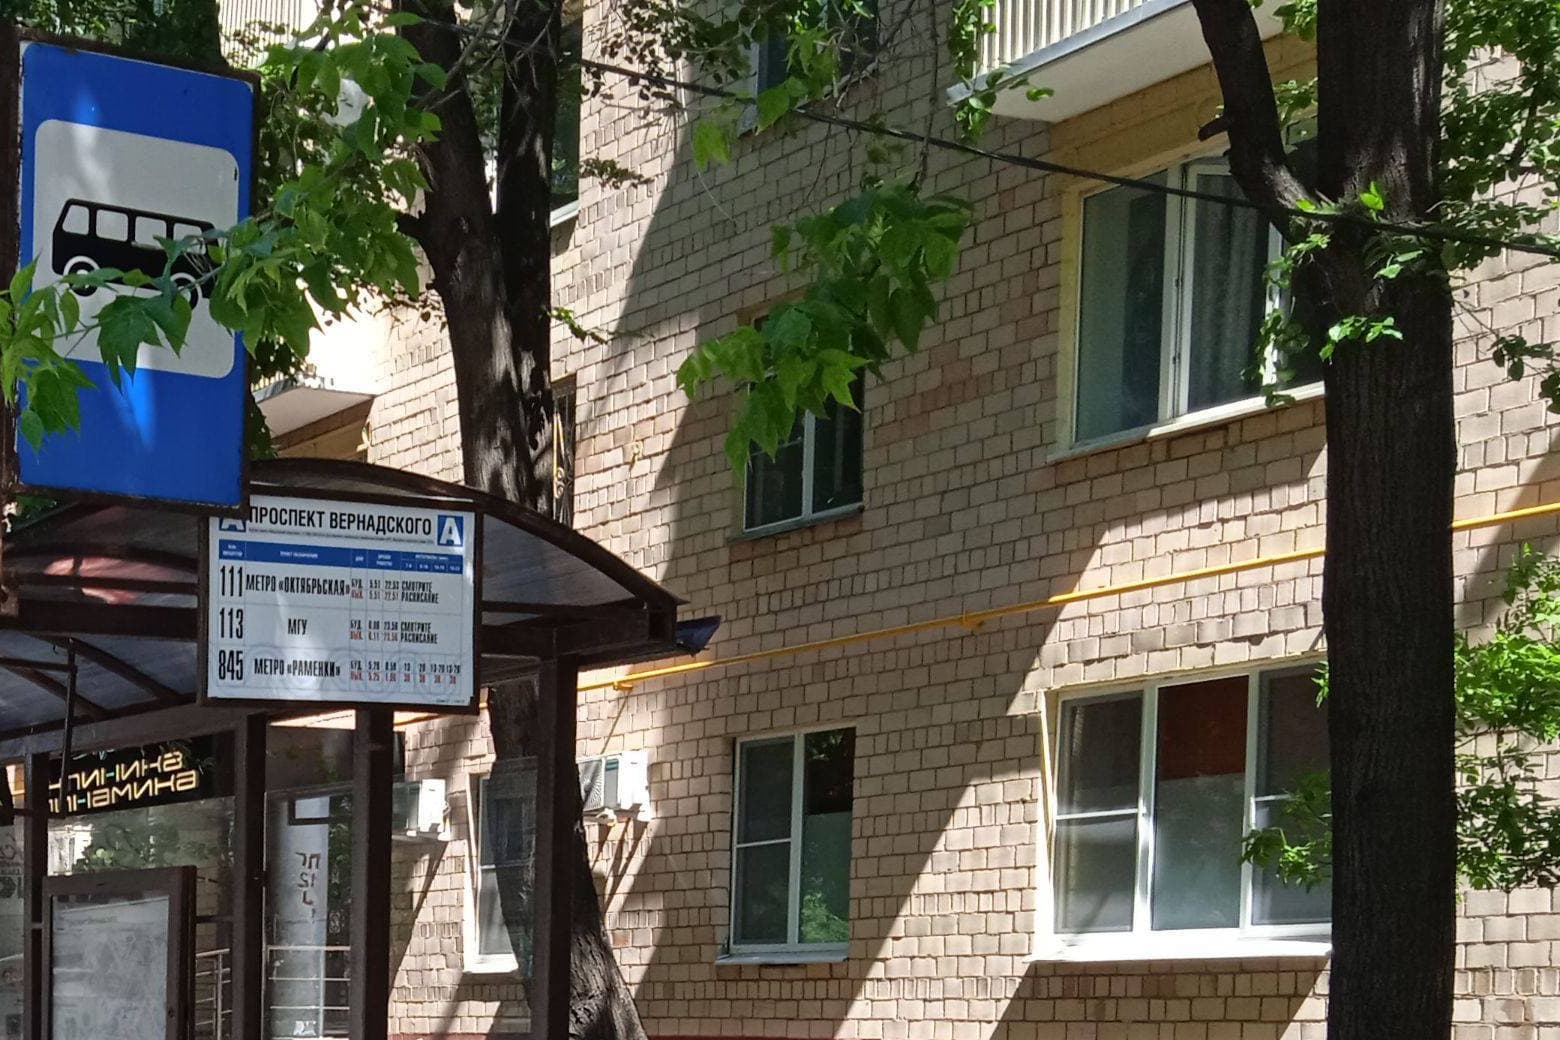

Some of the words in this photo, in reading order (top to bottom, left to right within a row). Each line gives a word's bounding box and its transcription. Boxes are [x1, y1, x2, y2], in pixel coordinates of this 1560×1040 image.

[249, 506, 325, 529] ПРОСПЕКТ
[329, 511, 432, 536] ВЕРНАДСКОГО
[220, 565, 243, 597] 111
[246, 574, 276, 592] МЕТРО
[279, 576, 350, 596] «ОКТЯБРЬСКАЯ»
[401, 580, 433, 592] СМОТРИТЕ
[401, 591, 440, 604] РАСПИСАНИЕ
[220, 607, 244, 639] 113
[287, 618, 308, 635] МГУ
[218, 650, 244, 680] 845
[254, 658, 285, 676] МЕТРО
[287, 660, 340, 677] «РАМЕНКИ»
